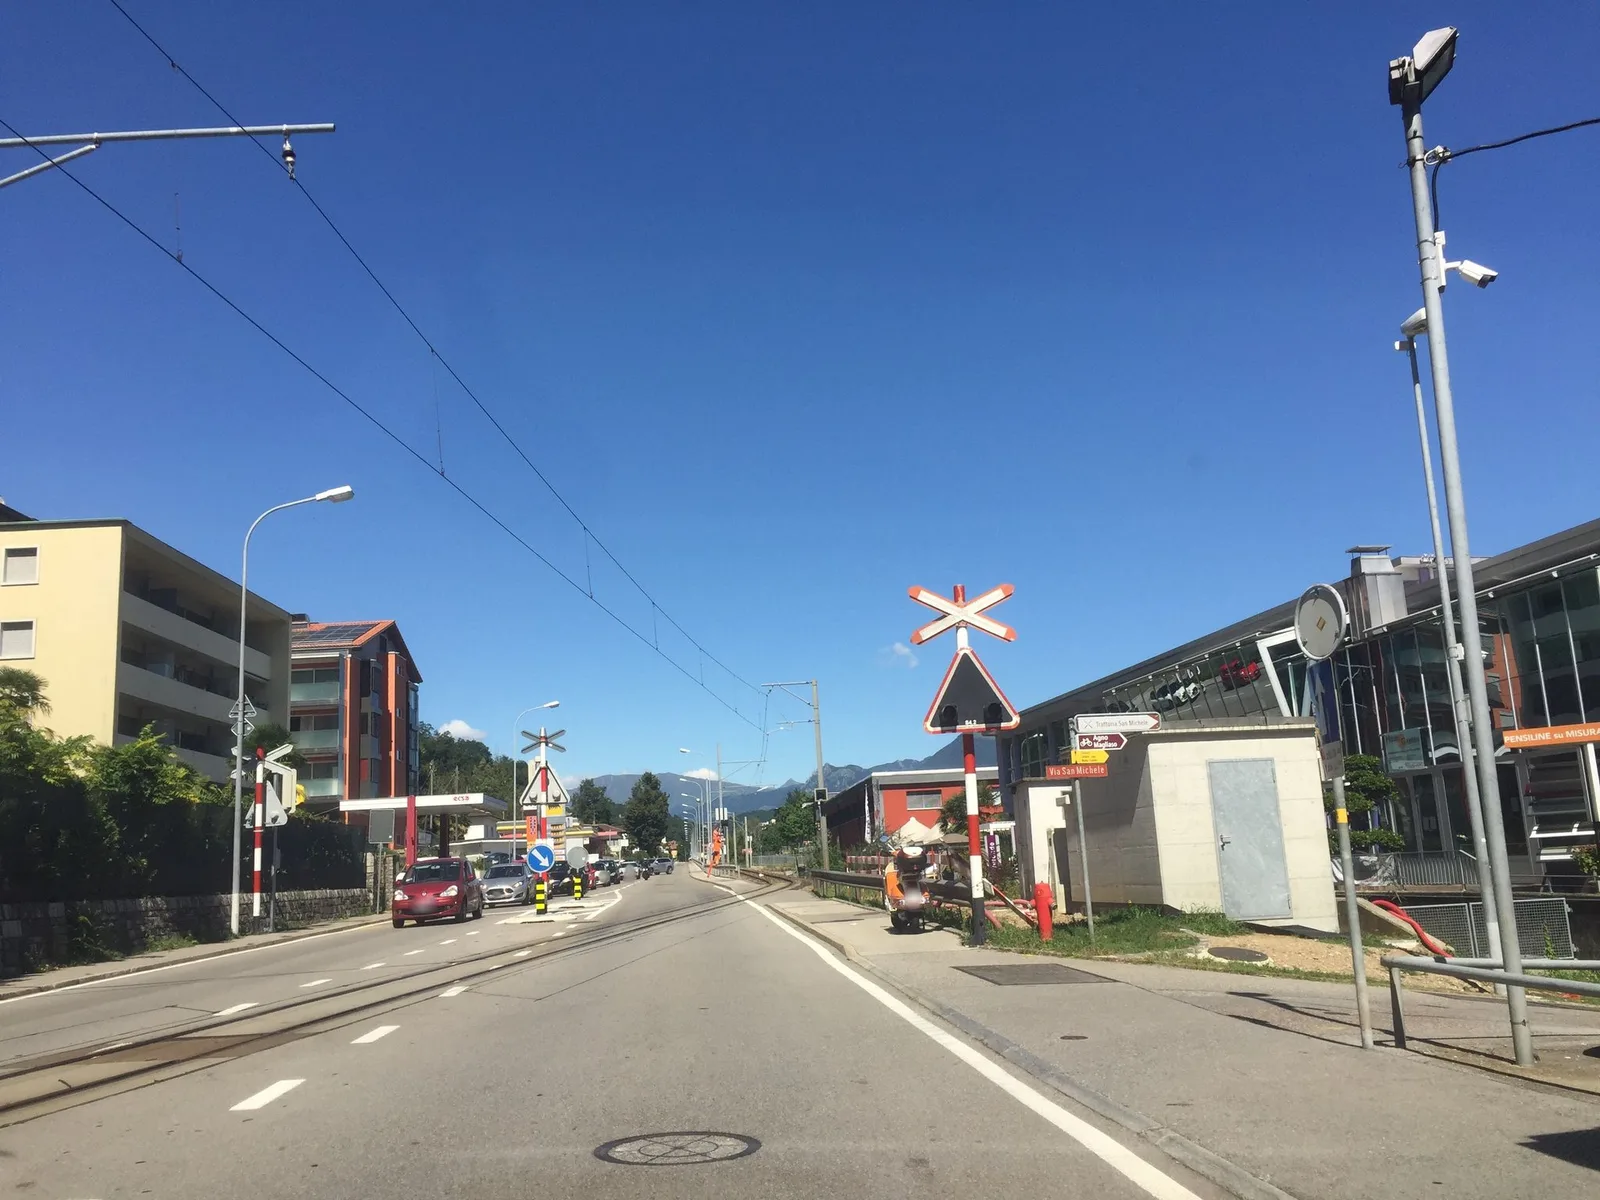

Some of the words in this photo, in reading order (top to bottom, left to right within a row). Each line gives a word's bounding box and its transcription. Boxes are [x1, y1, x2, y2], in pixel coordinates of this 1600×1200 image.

[1118, 719, 1128, 727] San
[1128, 718, 1149, 726] Michele
[1093, 734, 1109, 743] Agno
[1504, 732, 1551, 743] PENSILINE
[1093, 741, 1118, 749] Magliaso
[1049, 767, 1061, 776] Via
[1062, 767, 1075, 775] San
[1076, 766, 1105, 774] Michele
